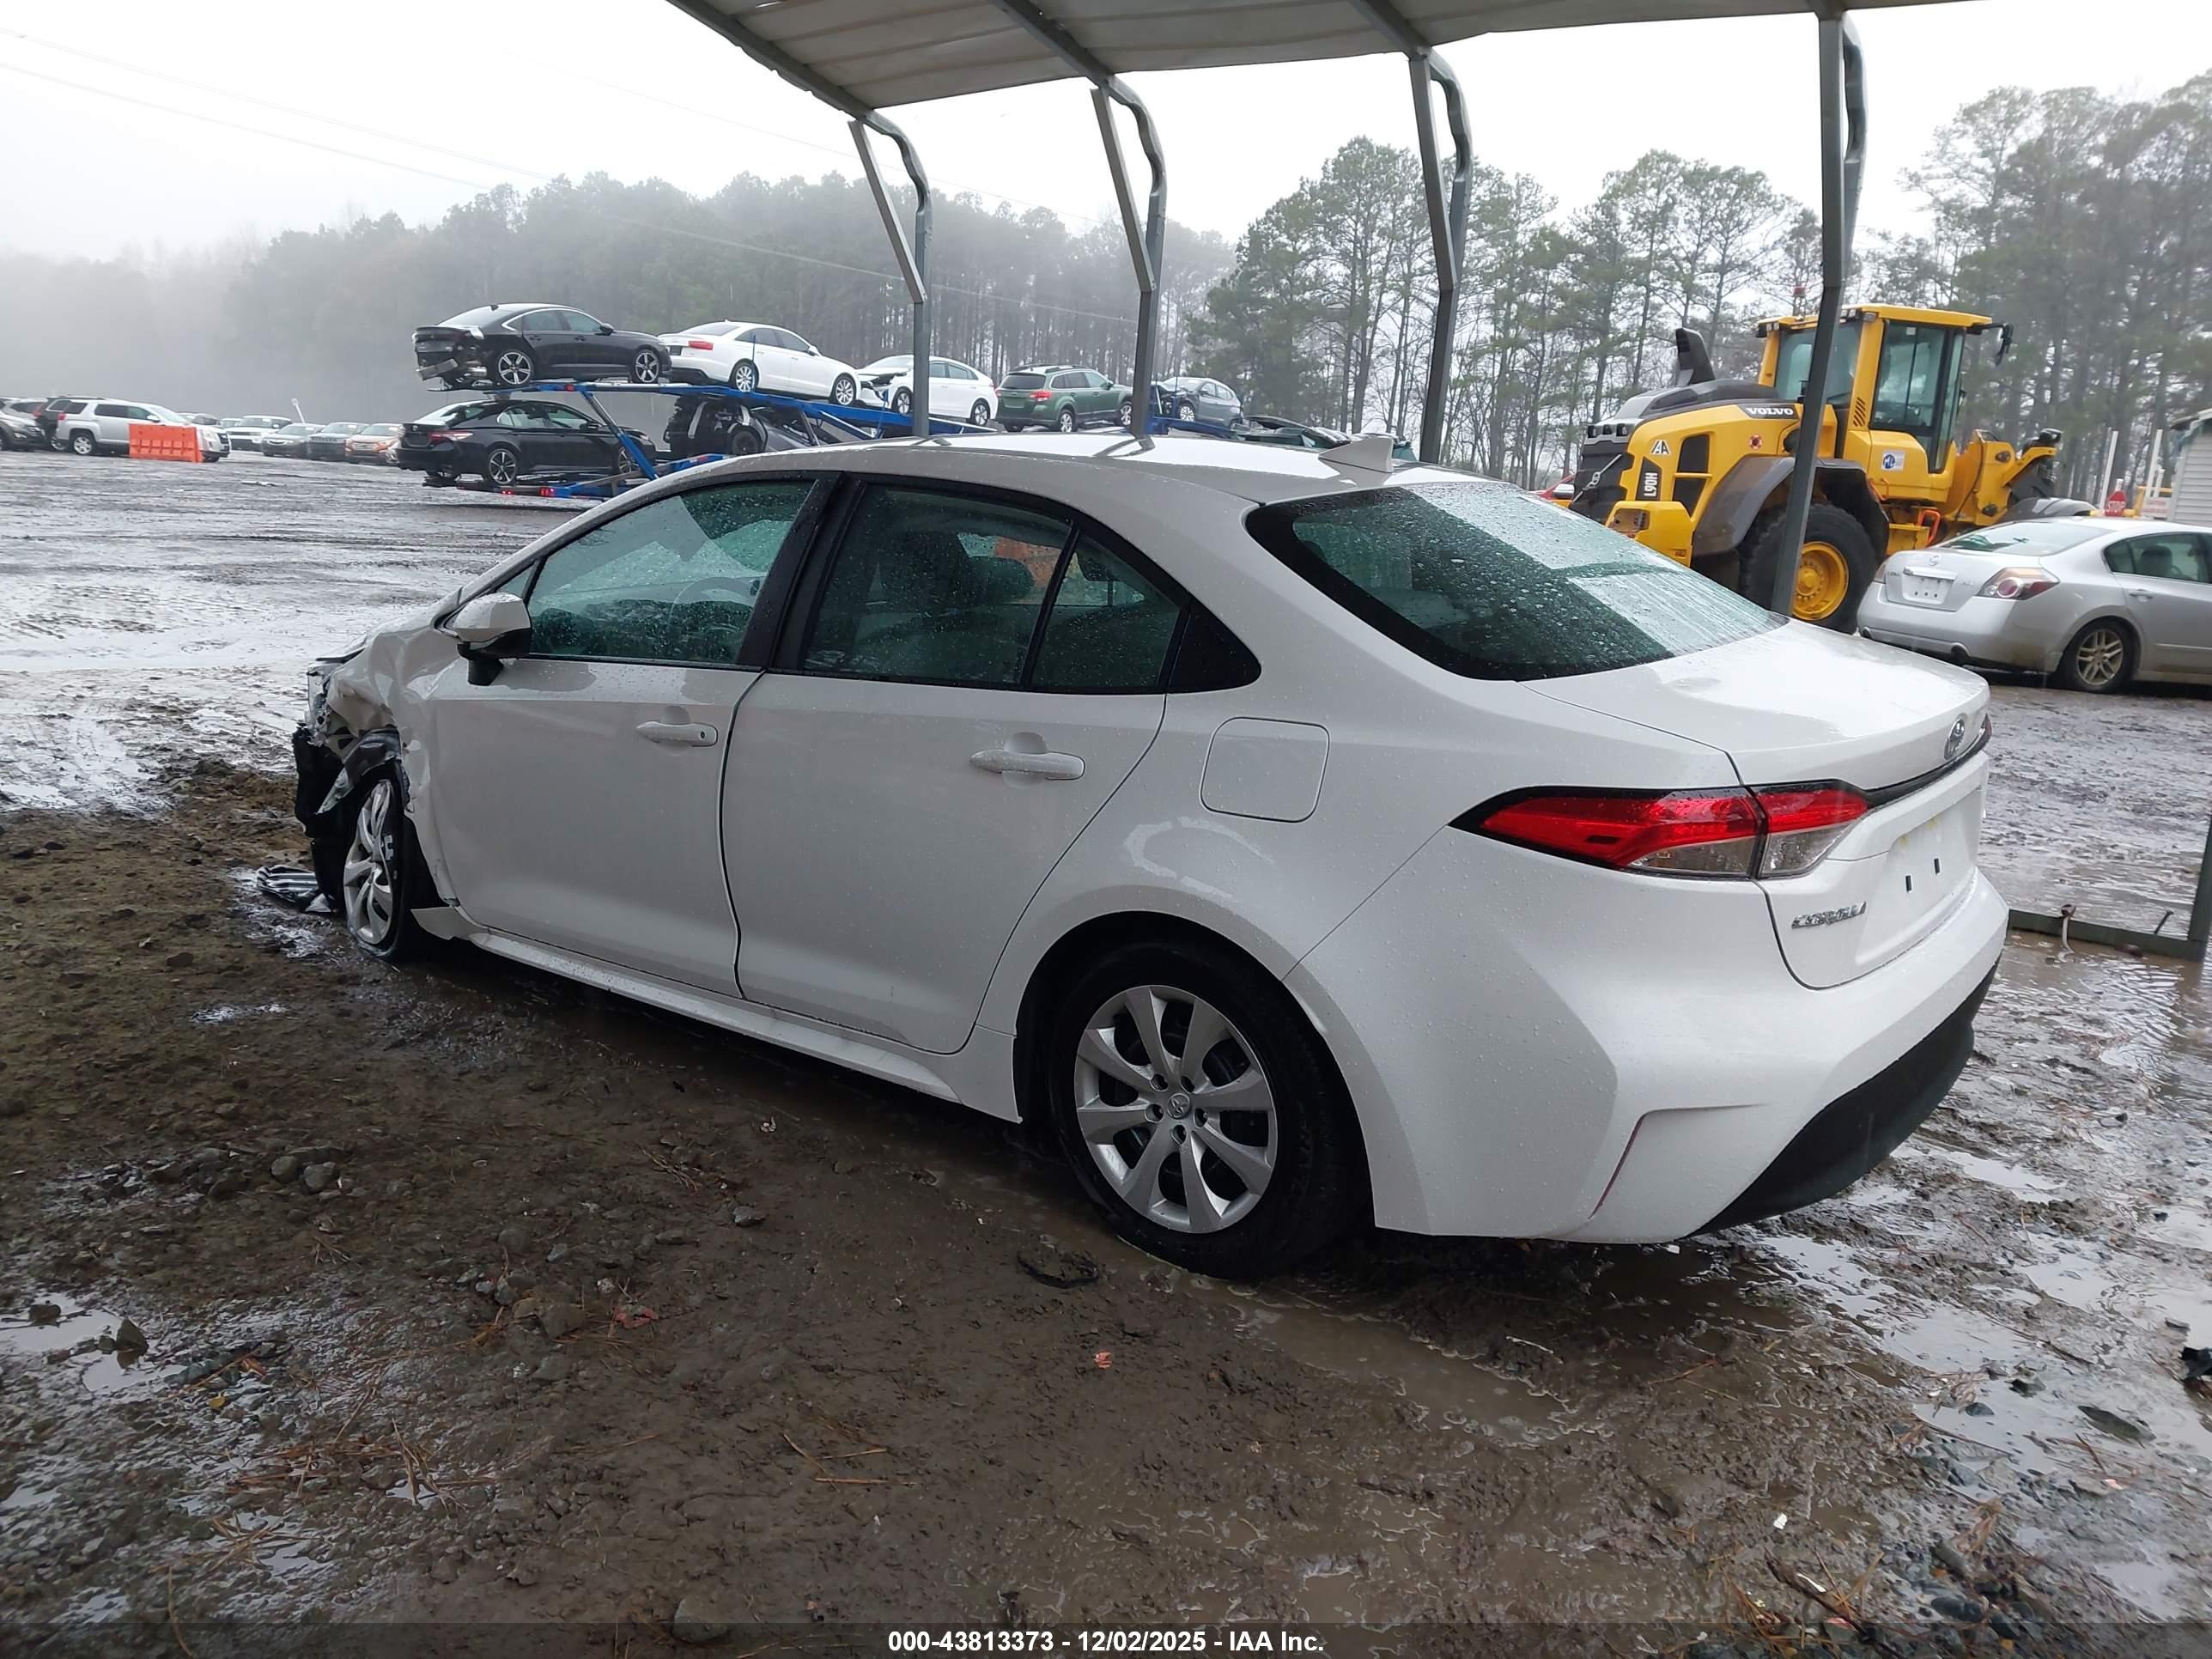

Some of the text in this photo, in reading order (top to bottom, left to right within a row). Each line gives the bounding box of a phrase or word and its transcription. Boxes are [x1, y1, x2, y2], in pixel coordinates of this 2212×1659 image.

[1746, 407, 1794, 416] VOLVO
[1644, 471, 1658, 497] L90H
[2107, 501, 2126, 513] STOP
